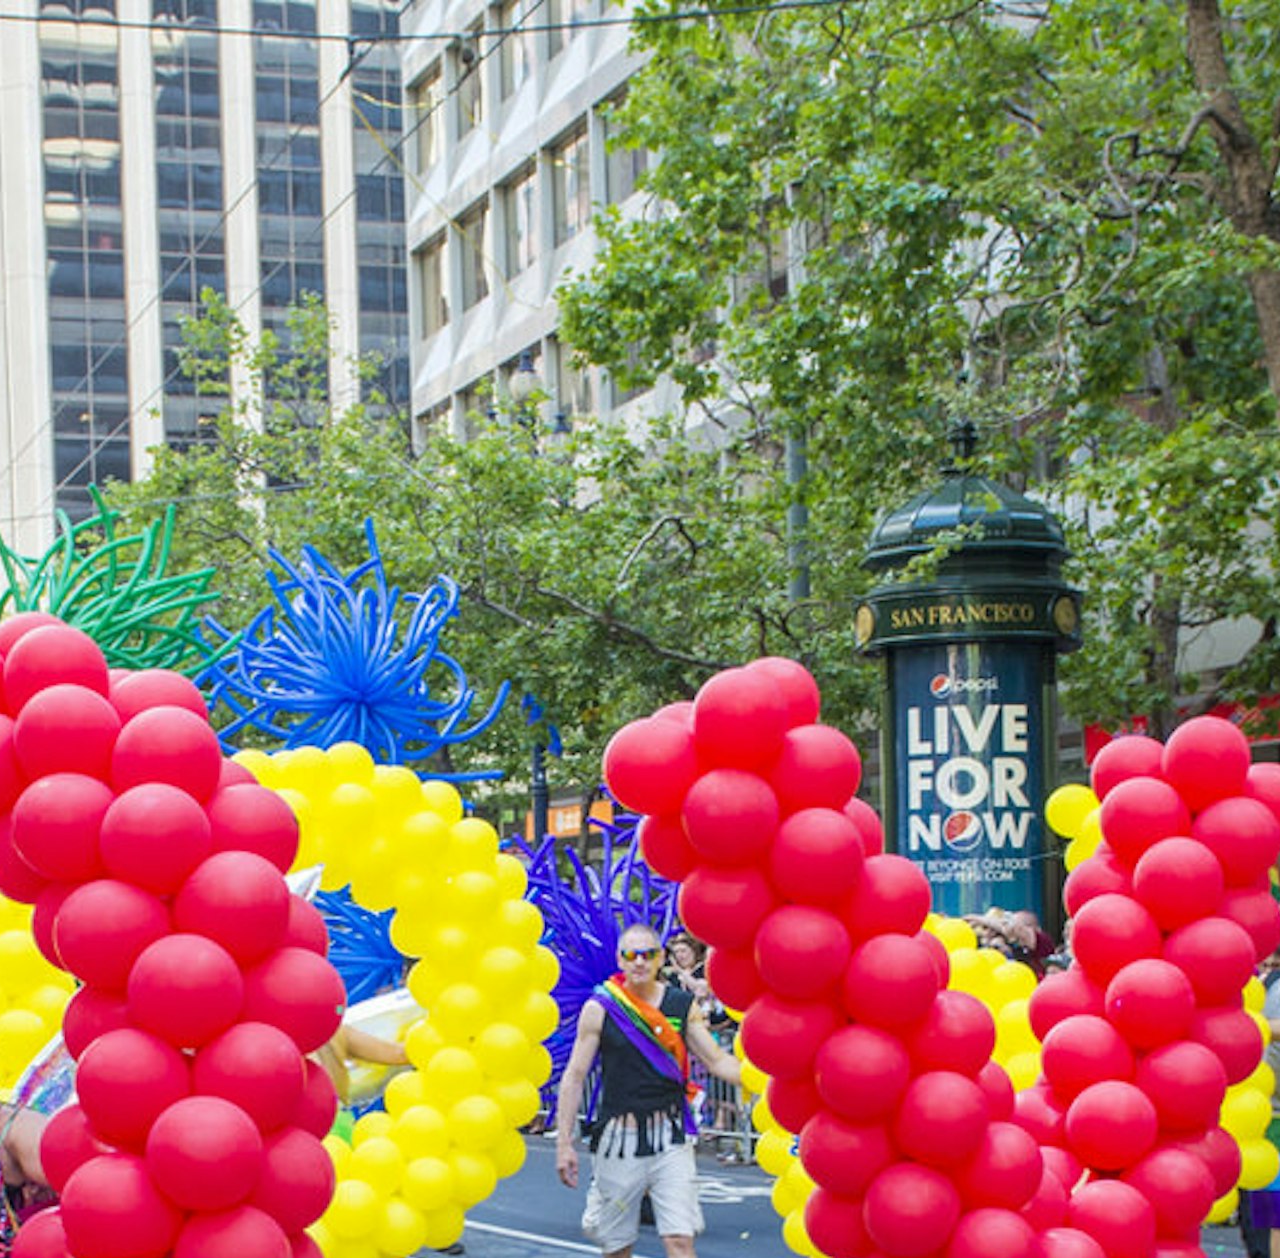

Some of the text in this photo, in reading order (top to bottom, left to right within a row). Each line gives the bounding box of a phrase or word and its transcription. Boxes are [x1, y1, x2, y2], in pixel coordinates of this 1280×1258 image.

[891, 603, 1035, 629] SAN FRANCISCO
[951, 675, 999, 693] pepsi
[908, 704, 1028, 755] LIVE
[908, 757, 1030, 810] FOR
[981, 857, 1002, 870] ON
